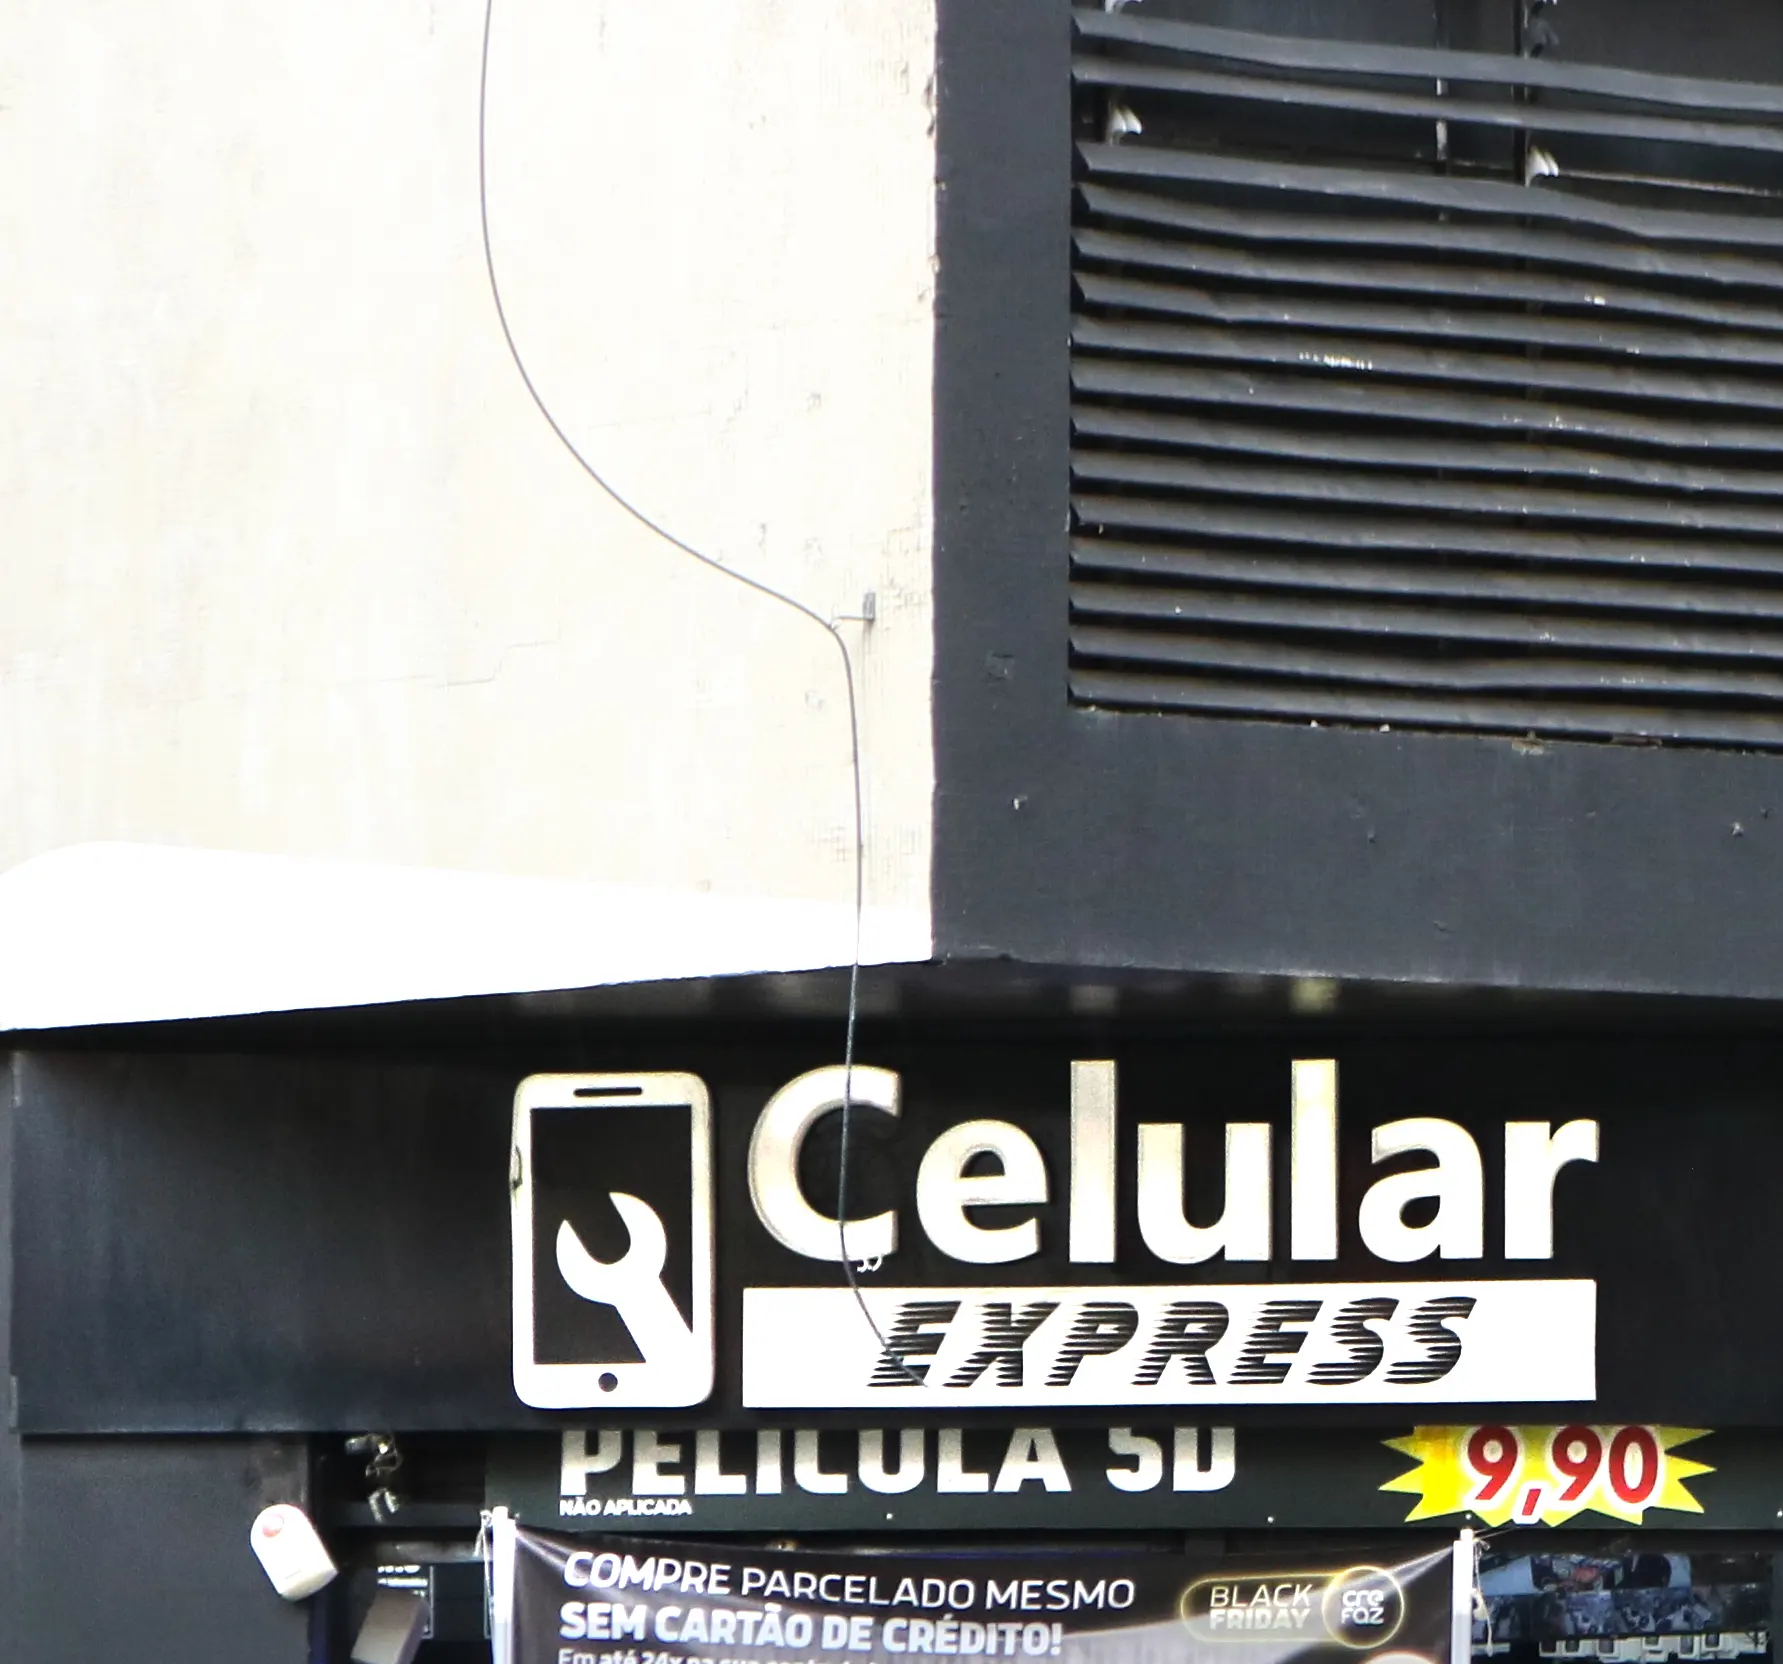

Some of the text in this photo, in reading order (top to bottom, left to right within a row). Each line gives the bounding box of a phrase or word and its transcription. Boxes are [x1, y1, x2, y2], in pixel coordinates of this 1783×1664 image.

[748, 1060, 1598, 1266] Celular
[868, 1296, 1478, 1390] EXPRESS
[1466, 1426, 1660, 1517] 9,90
[559, 1497, 693, 1517] NÃO APLICADA
[563, 1550, 1135, 1611] COMPRE PARCELADO MESMO
[1210, 1584, 1312, 1607] BLACK
[559, 1603, 1063, 1656] SEM CARTÃO DE CRÉDITO!
[1210, 1608, 1312, 1630] FRIDAY
